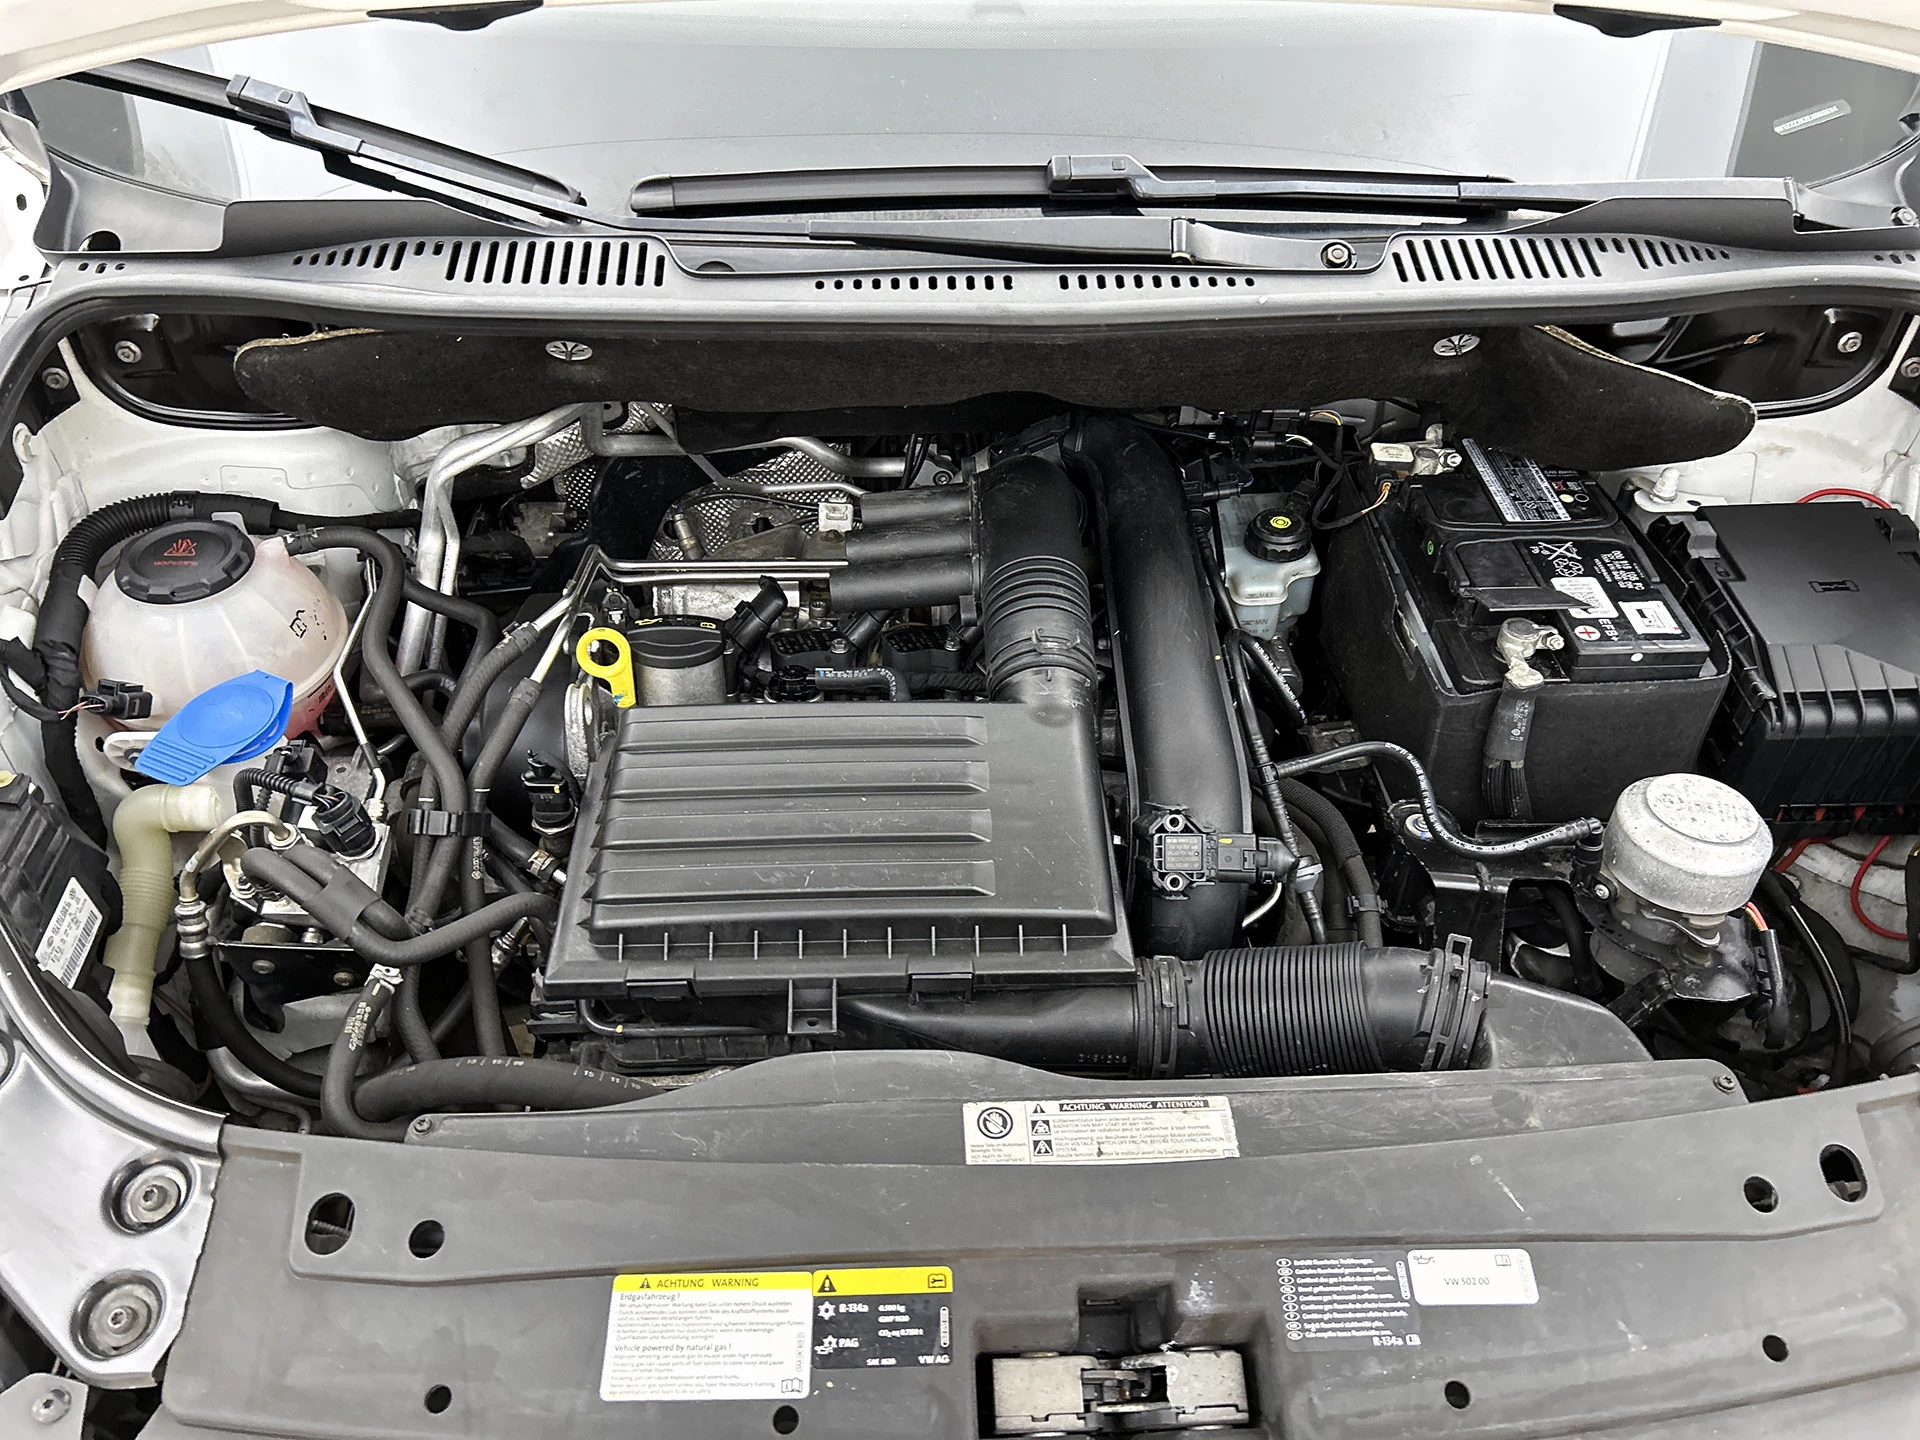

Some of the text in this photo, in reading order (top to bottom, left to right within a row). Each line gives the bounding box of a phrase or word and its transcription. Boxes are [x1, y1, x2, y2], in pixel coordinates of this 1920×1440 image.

[1598, 618, 1620, 642] EFB+
[1062, 1100, 1204, 1111] ACHTUNG WARNING ATTENTION
[657, 1277, 759, 1288] ACHTUNG WARNING
[1461, 1277, 1477, 1285] 502
[1478, 1277, 1490, 1285] 00
[620, 1293, 676, 1302] Erdgasfahrzeug
[839, 1303, 869, 1313] R-134a
[642, 1344, 674, 1353] powered
[676, 1344, 684, 1353] by
[687, 1343, 713, 1351] natural
[714, 1344, 727, 1353] gas
[838, 1338, 859, 1348] PAG
[918, 1355, 950, 1364] VW AG
